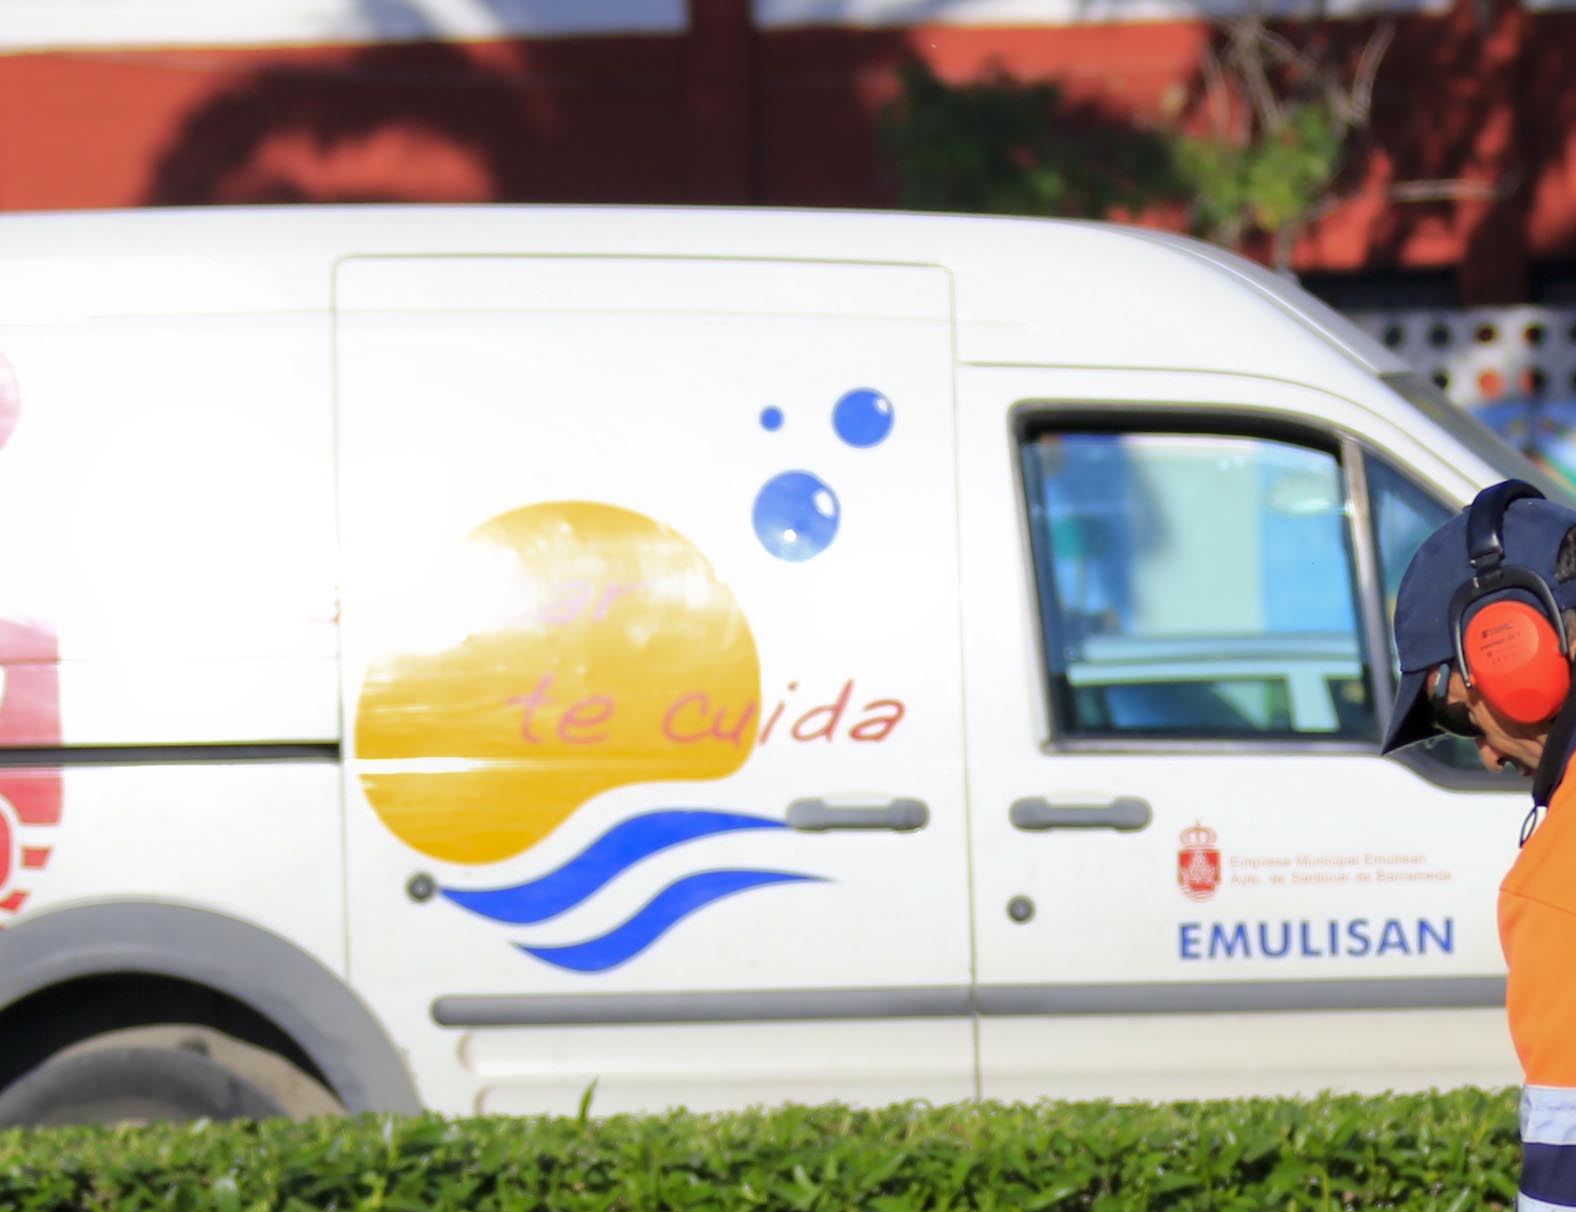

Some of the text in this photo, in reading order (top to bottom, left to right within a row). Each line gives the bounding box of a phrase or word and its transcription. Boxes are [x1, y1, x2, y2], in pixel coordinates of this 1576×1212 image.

[504, 671, 907, 748] te cuida
[1230, 853, 1426, 869] Empresa Municipal Emulisan
[1178, 916, 1455, 960] EMULISAN
